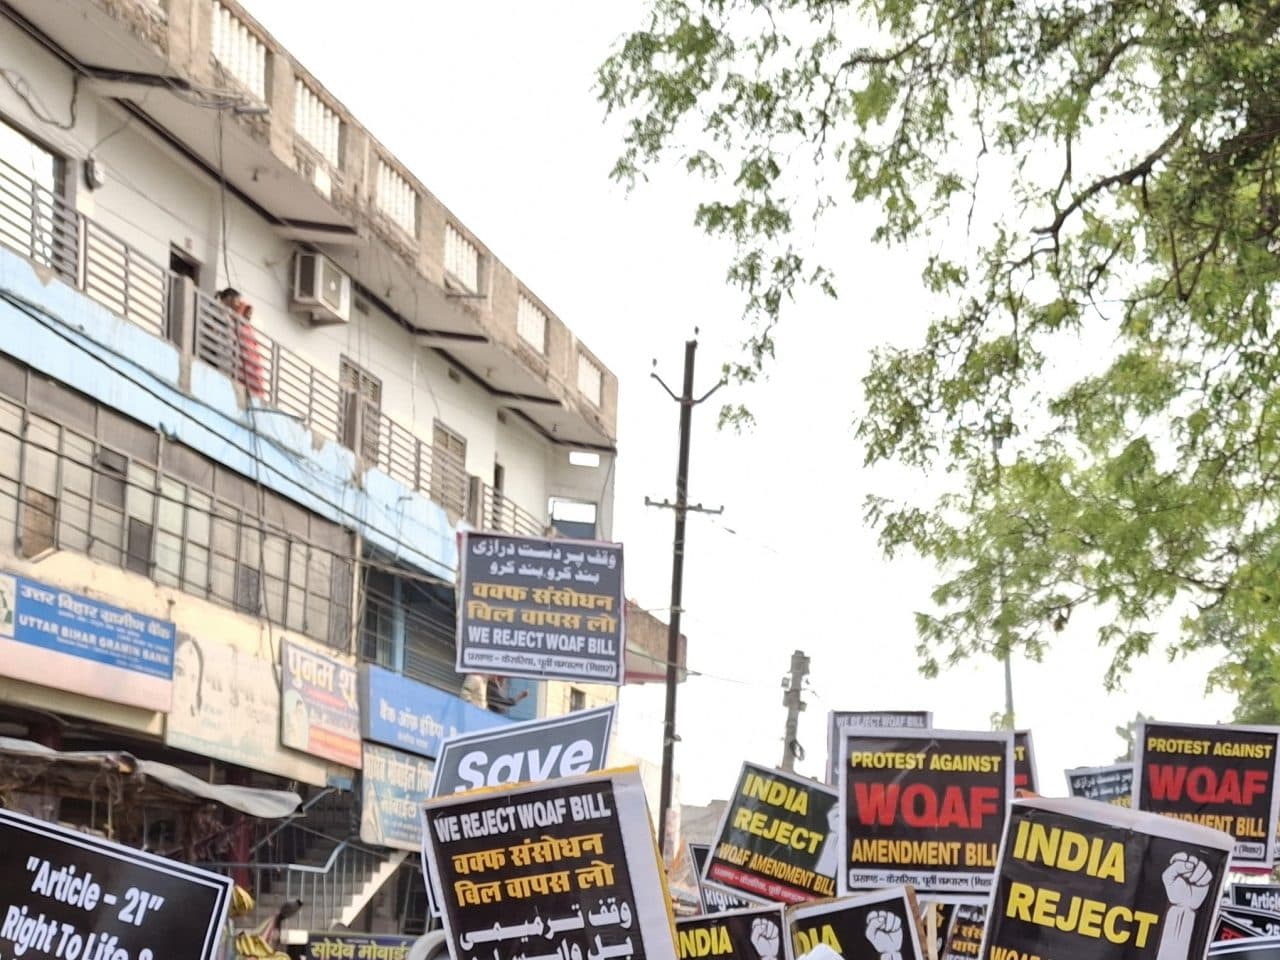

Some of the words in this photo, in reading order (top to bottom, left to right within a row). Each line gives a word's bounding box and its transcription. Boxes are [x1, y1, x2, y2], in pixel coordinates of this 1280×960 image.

[19, 614, 58, 634] UTTAR
[61, 626, 97, 645] BIHAR
[99, 637, 140, 657] GRAMIN
[143, 649, 170, 665] BANK
[468, 625, 489, 643] WE
[493, 628, 544, 649] REJECT
[546, 633, 585, 651] WQAF
[588, 638, 616, 655] BILL
[455, 738, 594, 792] Save
[852, 752, 926, 771] PROTEST
[930, 754, 1001, 773] AGAINST
[1148, 737, 1211, 754] PROTEST
[1213, 742, 1273, 760] AGAINST
[742, 773, 808, 816] INDIA
[854, 782, 999, 829] WQAF
[1149, 763, 1269, 806] WQAF
[434, 815, 458, 844] WE
[460, 806, 516, 839] REJECT
[520, 797, 567, 830] WQAF
[571, 792, 611, 822] BILL
[734, 807, 823, 854] REJECT
[1235, 817, 1266, 837] BILL
[719, 842, 751, 866] WQAF
[750, 853, 815, 888] AMENDMENT
[814, 871, 835, 896] BILL
[852, 838, 961, 866] AMENDMENT
[965, 842, 998, 867] BILL
[1012, 820, 1125, 883] INDIA
[1, 905, 58, 956] Right
[1006, 882, 1159, 948] REJECT
